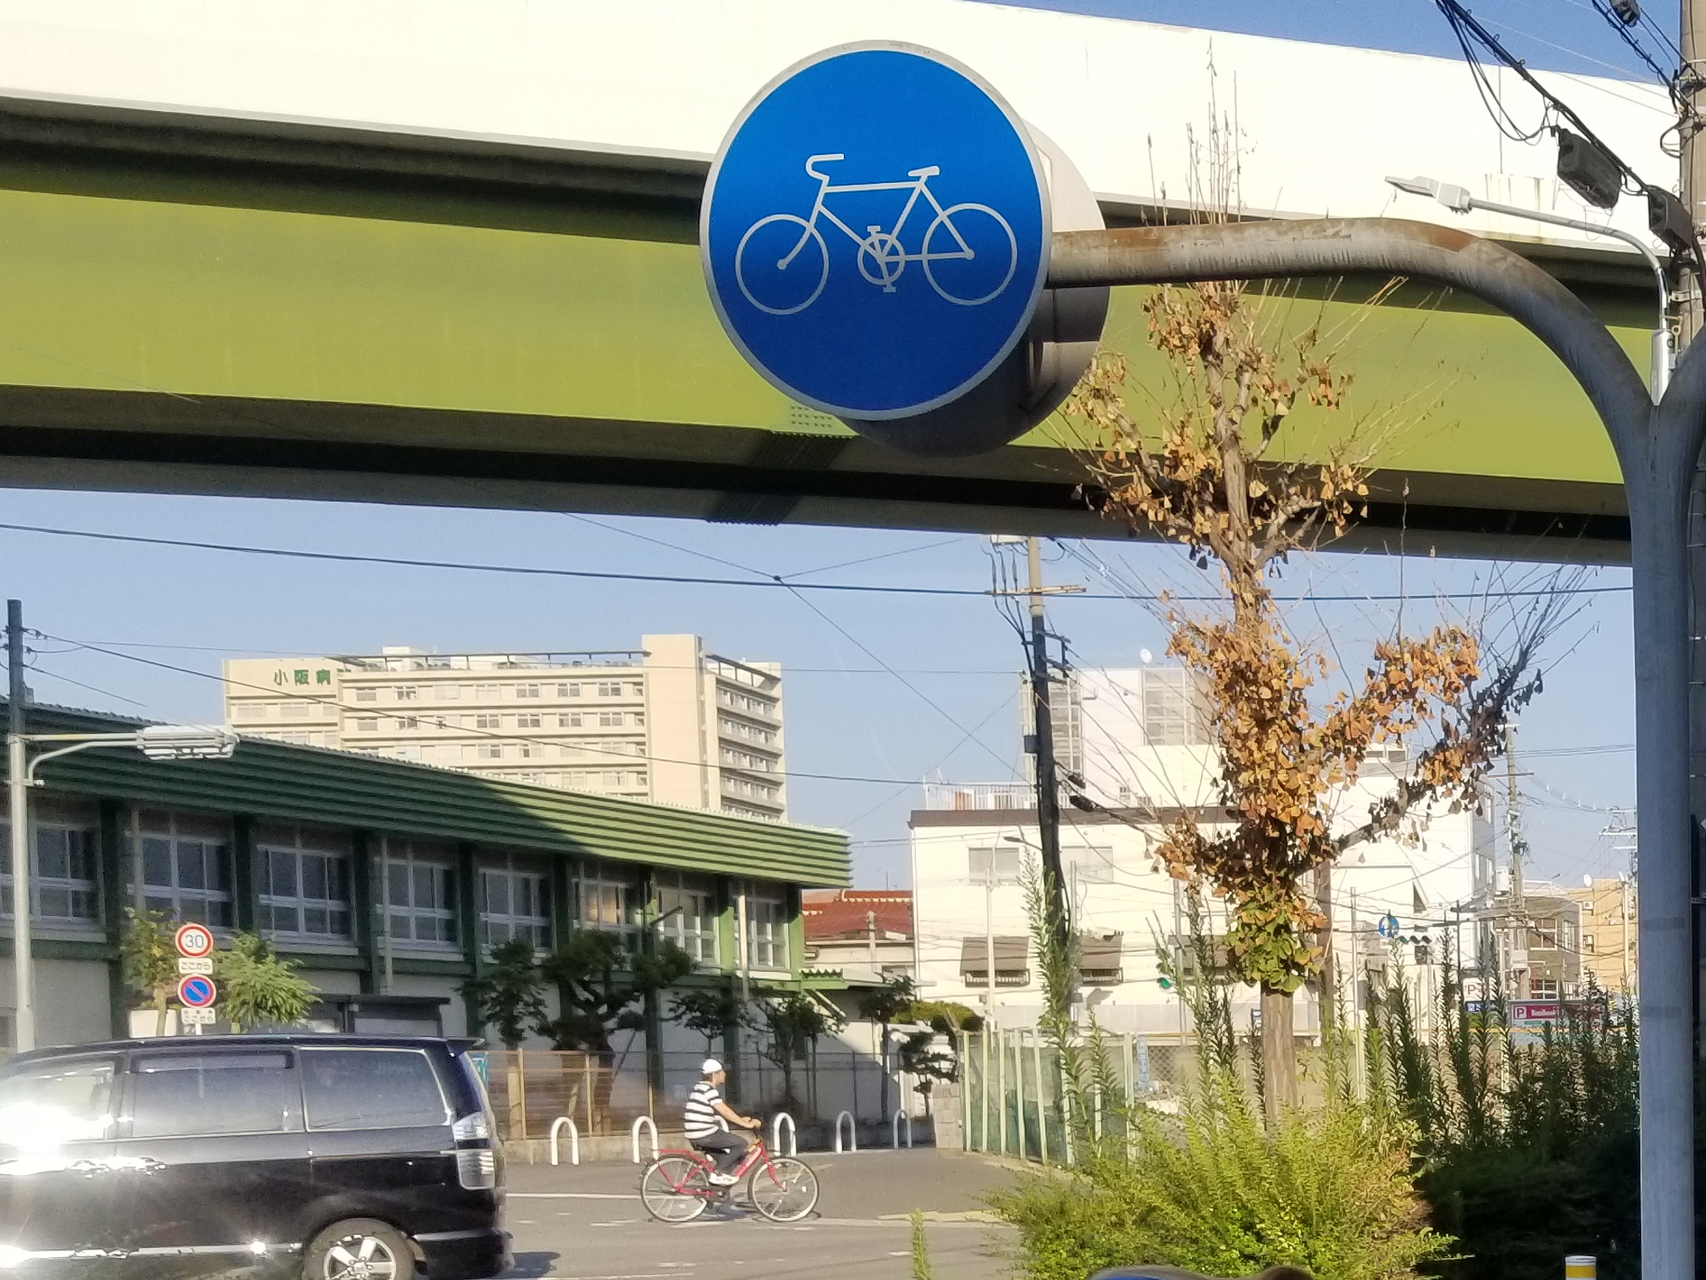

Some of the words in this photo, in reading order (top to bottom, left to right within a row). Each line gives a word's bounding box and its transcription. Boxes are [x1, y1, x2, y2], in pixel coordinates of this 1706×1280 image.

[273, 668, 352, 686] 小阪病
[185, 934, 204, 948] 30
[181, 962, 211, 970] ここから
[1517, 1008, 1524, 1017] P
